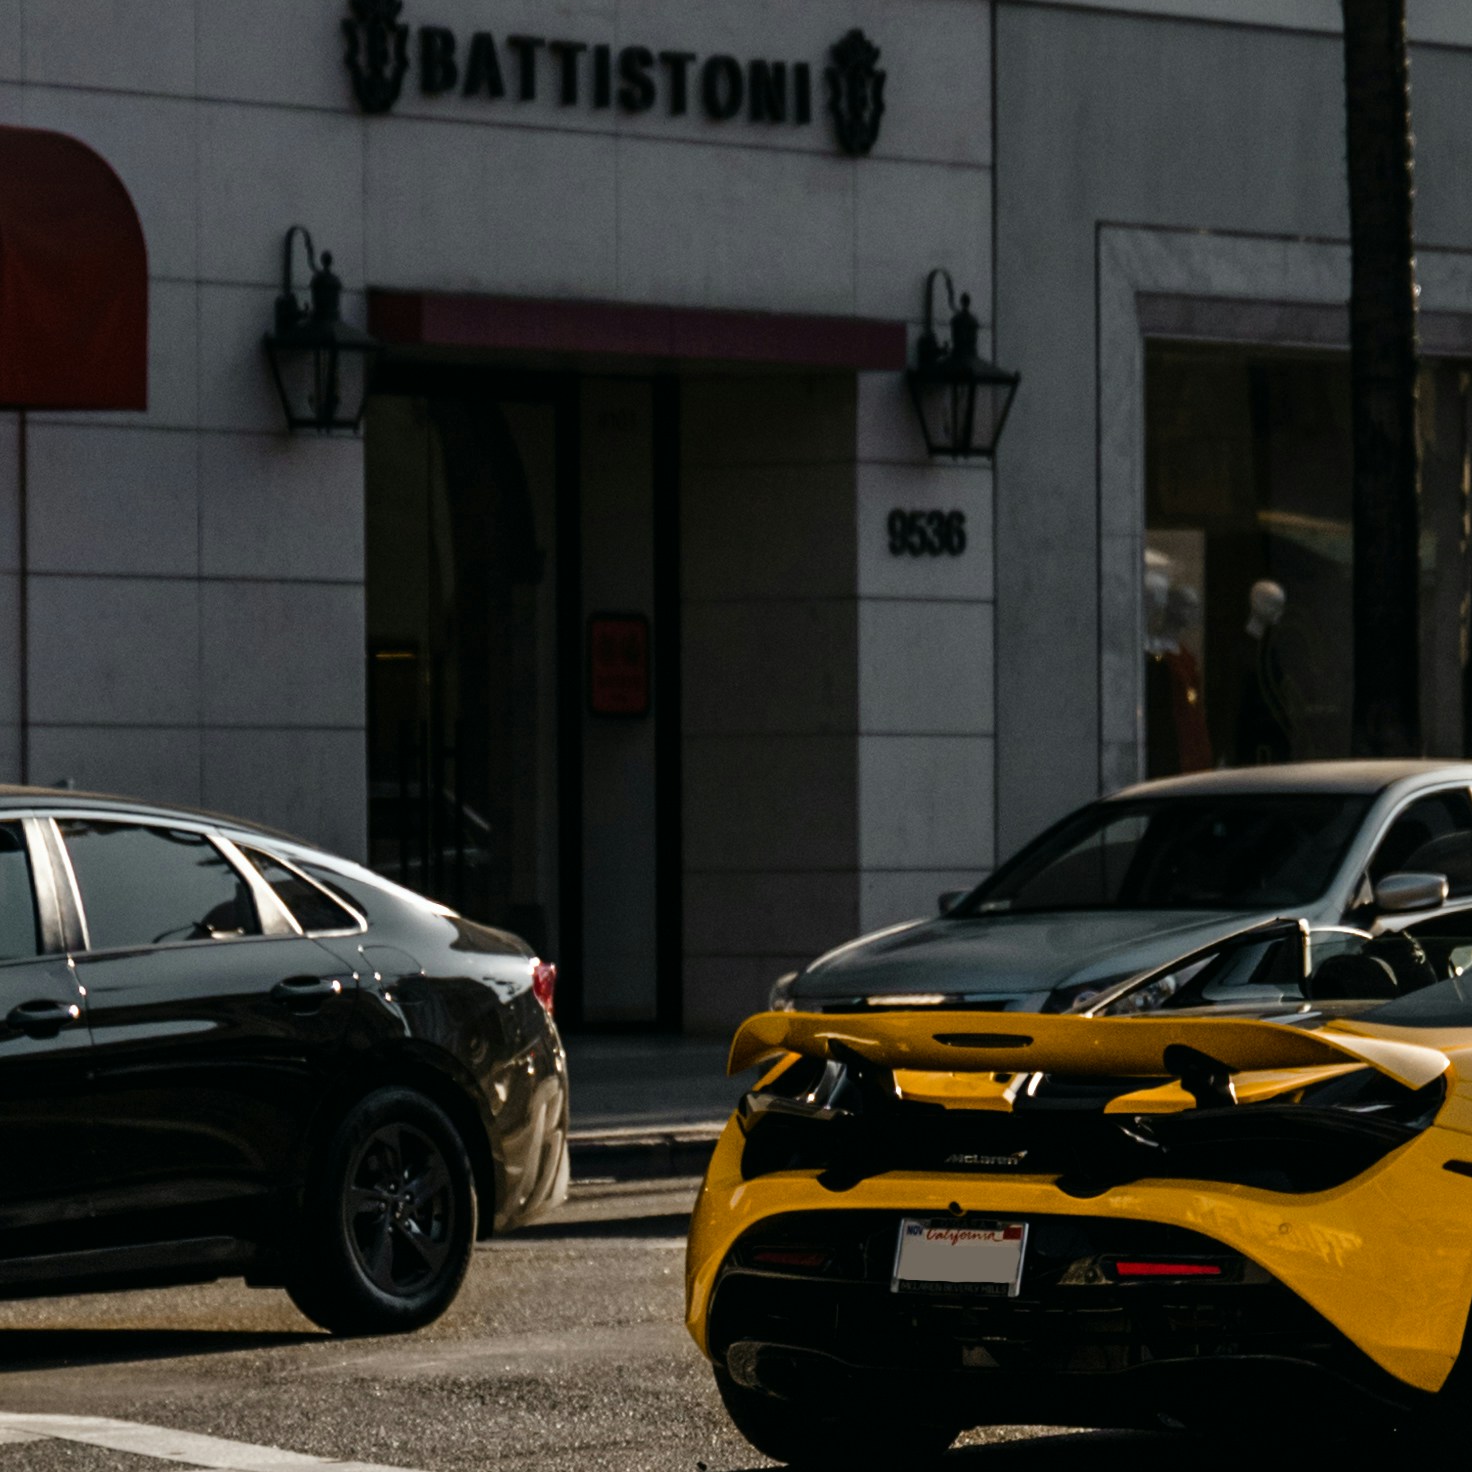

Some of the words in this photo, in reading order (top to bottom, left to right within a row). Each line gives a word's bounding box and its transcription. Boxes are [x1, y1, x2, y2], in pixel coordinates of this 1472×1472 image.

[417, 24, 812, 127] BATTISTONI
[887, 507, 967, 558] 9536
[944, 1152, 1020, 1166] McLaren
[906, 1225, 923, 1236] NOV
[926, 1228, 1003, 1246] California
